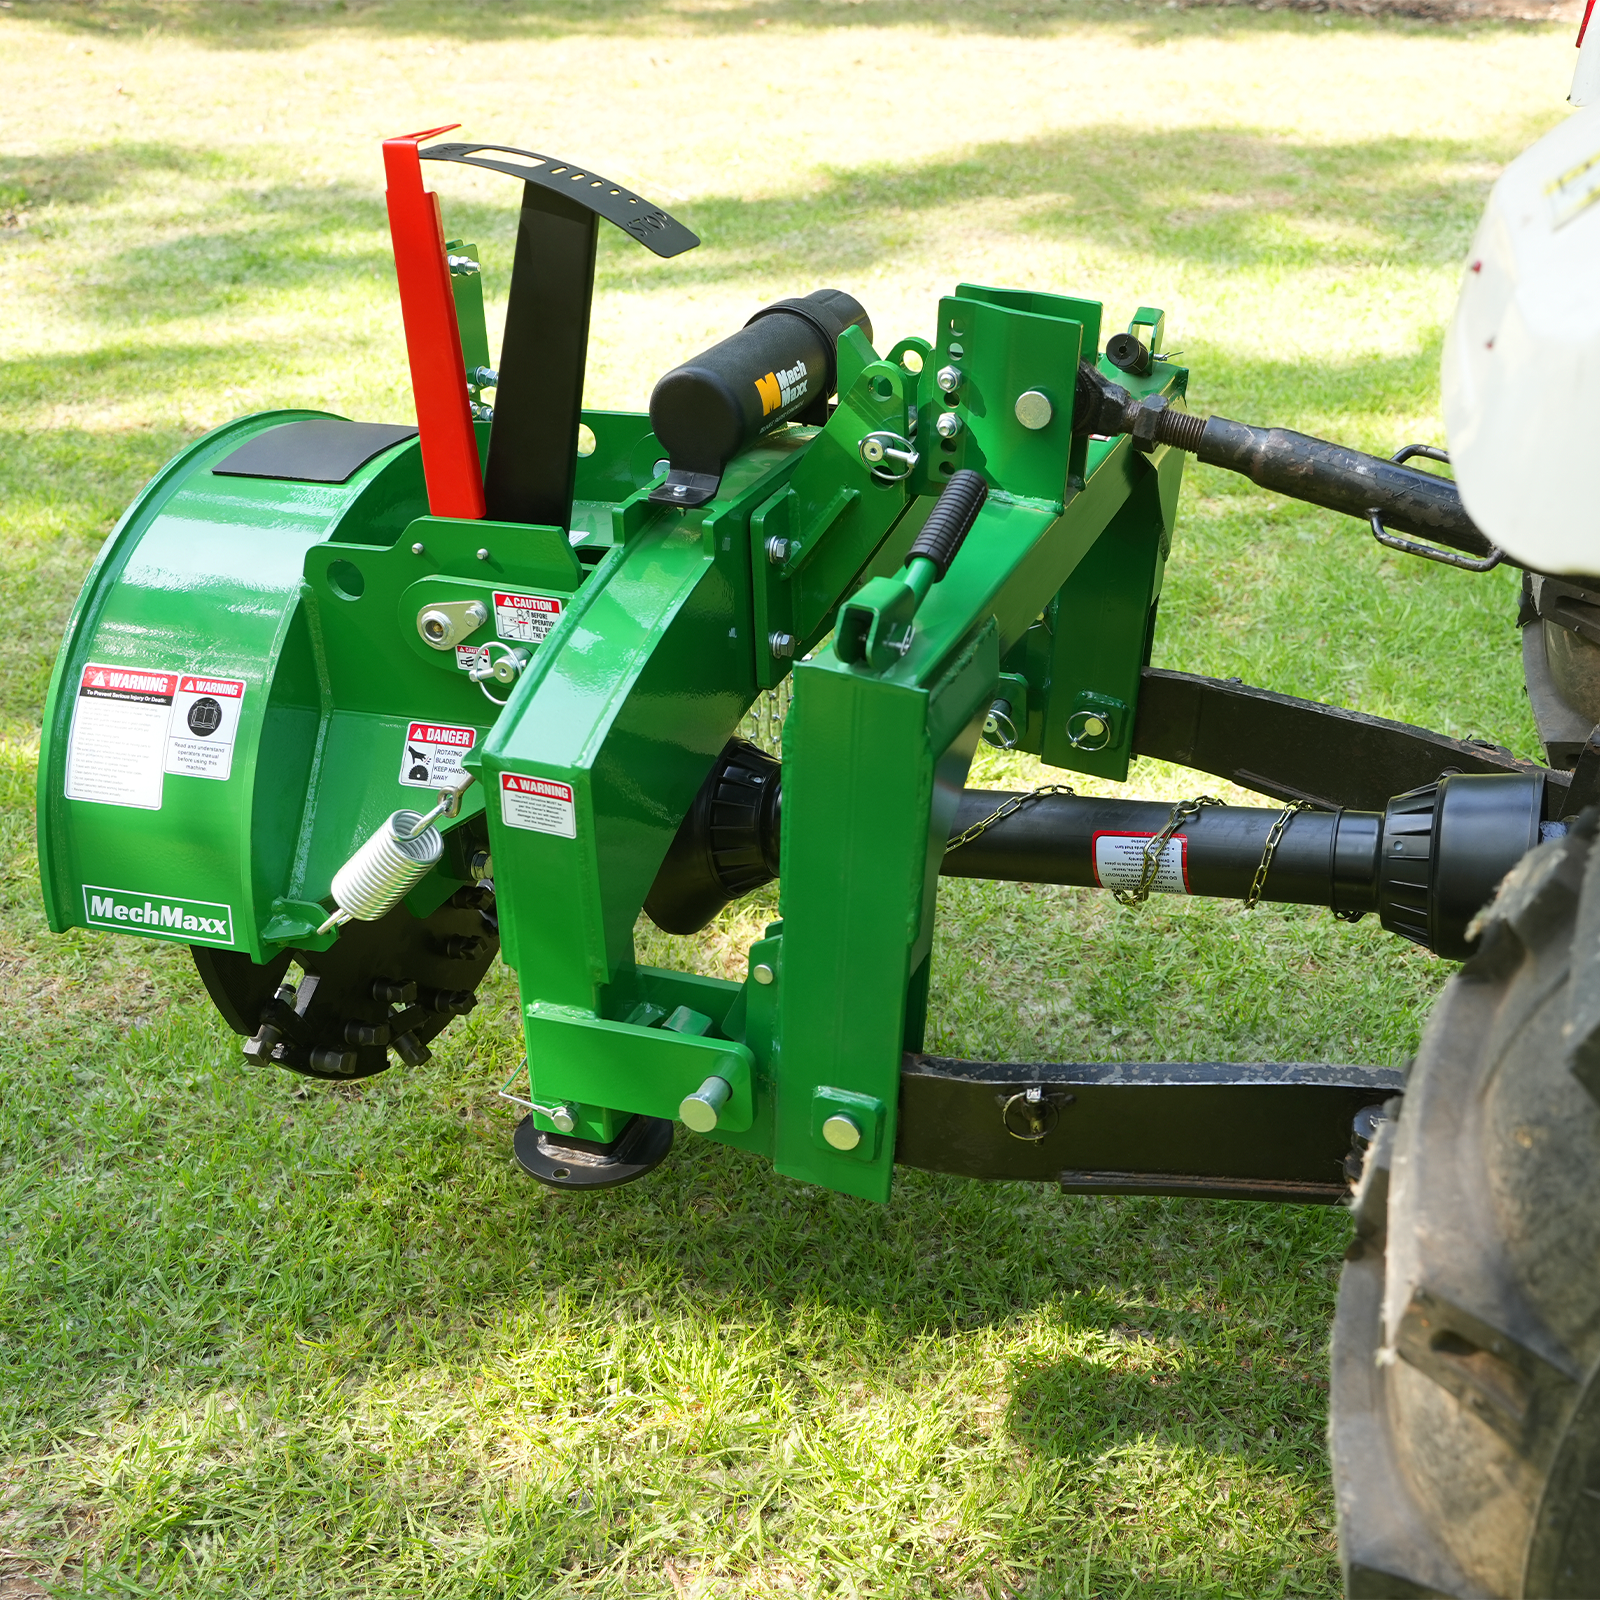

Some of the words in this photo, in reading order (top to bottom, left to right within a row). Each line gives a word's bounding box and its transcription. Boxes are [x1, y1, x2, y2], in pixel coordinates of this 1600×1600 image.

[627, 212, 671, 237] STOP
[776, 360, 807, 390] Mech
[781, 380, 807, 408] Maxx
[514, 598, 552, 611] CAUTION
[531, 612, 548, 620] BEFORE
[532, 619, 554, 627] OPERATIO
[110, 672, 168, 692] WARNING
[196, 681, 239, 695] WARNING
[426, 728, 470, 744] DANGER
[519, 779, 568, 799] WARNING
[91, 895, 226, 935] MechMaxx
